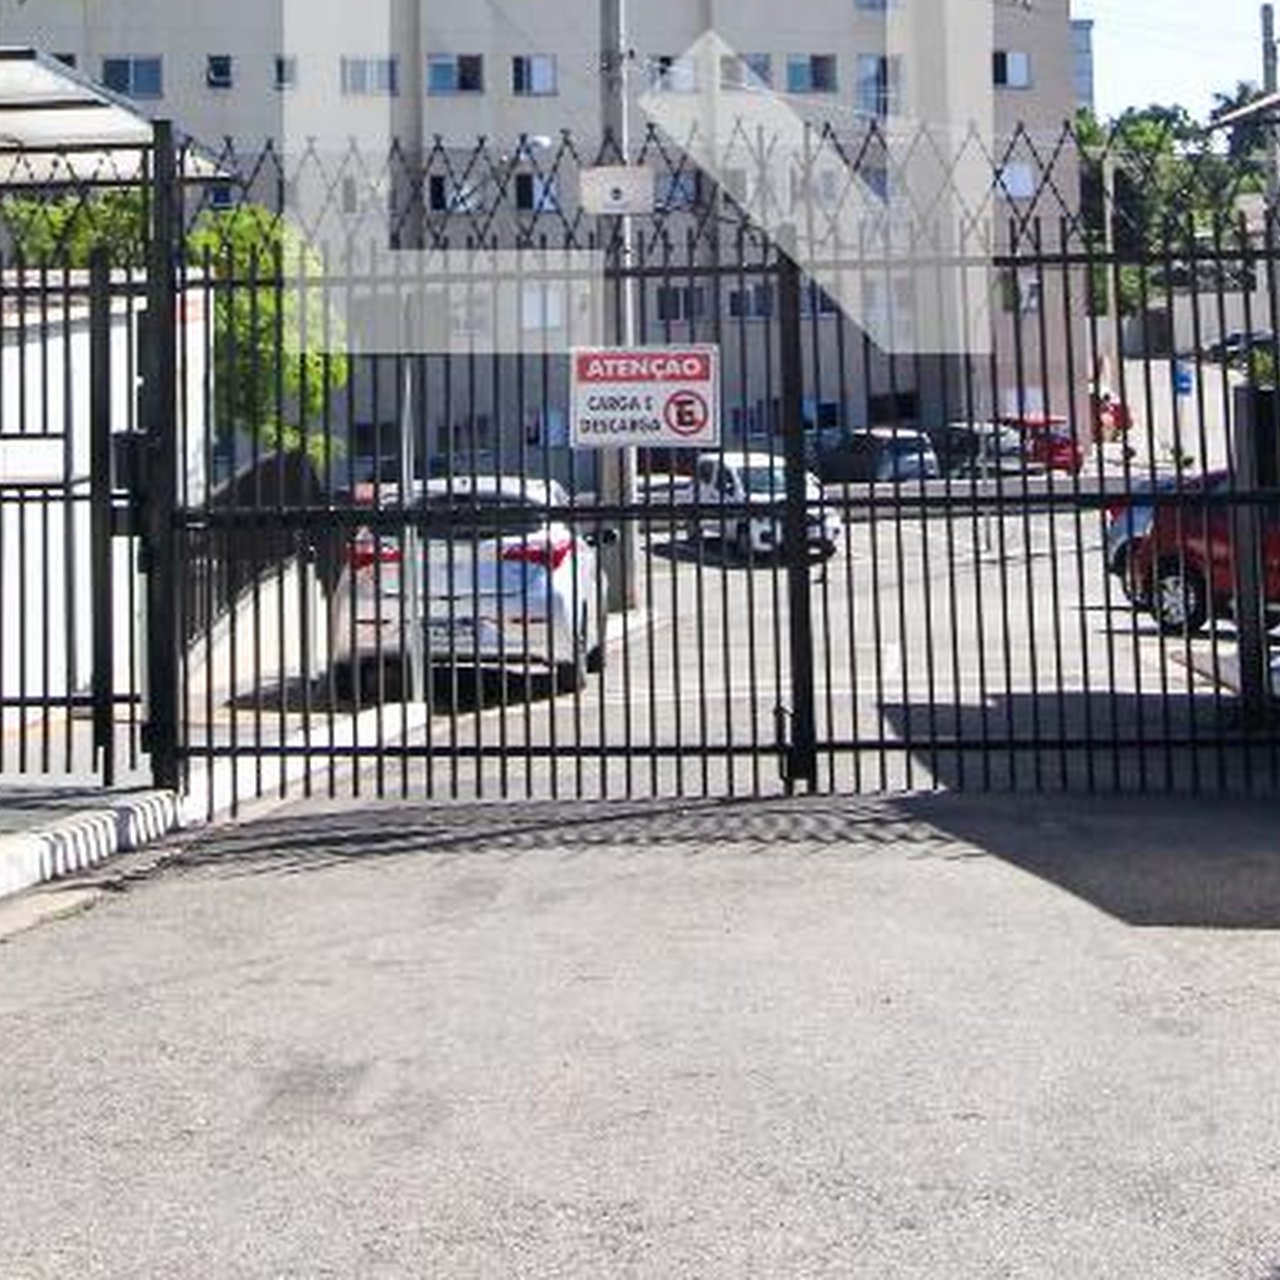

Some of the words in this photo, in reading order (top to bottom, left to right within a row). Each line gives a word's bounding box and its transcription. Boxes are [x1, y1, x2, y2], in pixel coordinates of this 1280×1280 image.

[587, 396, 641, 412] CARGA
[644, 395, 654, 411] E
[580, 418, 662, 434] DESCARGA
